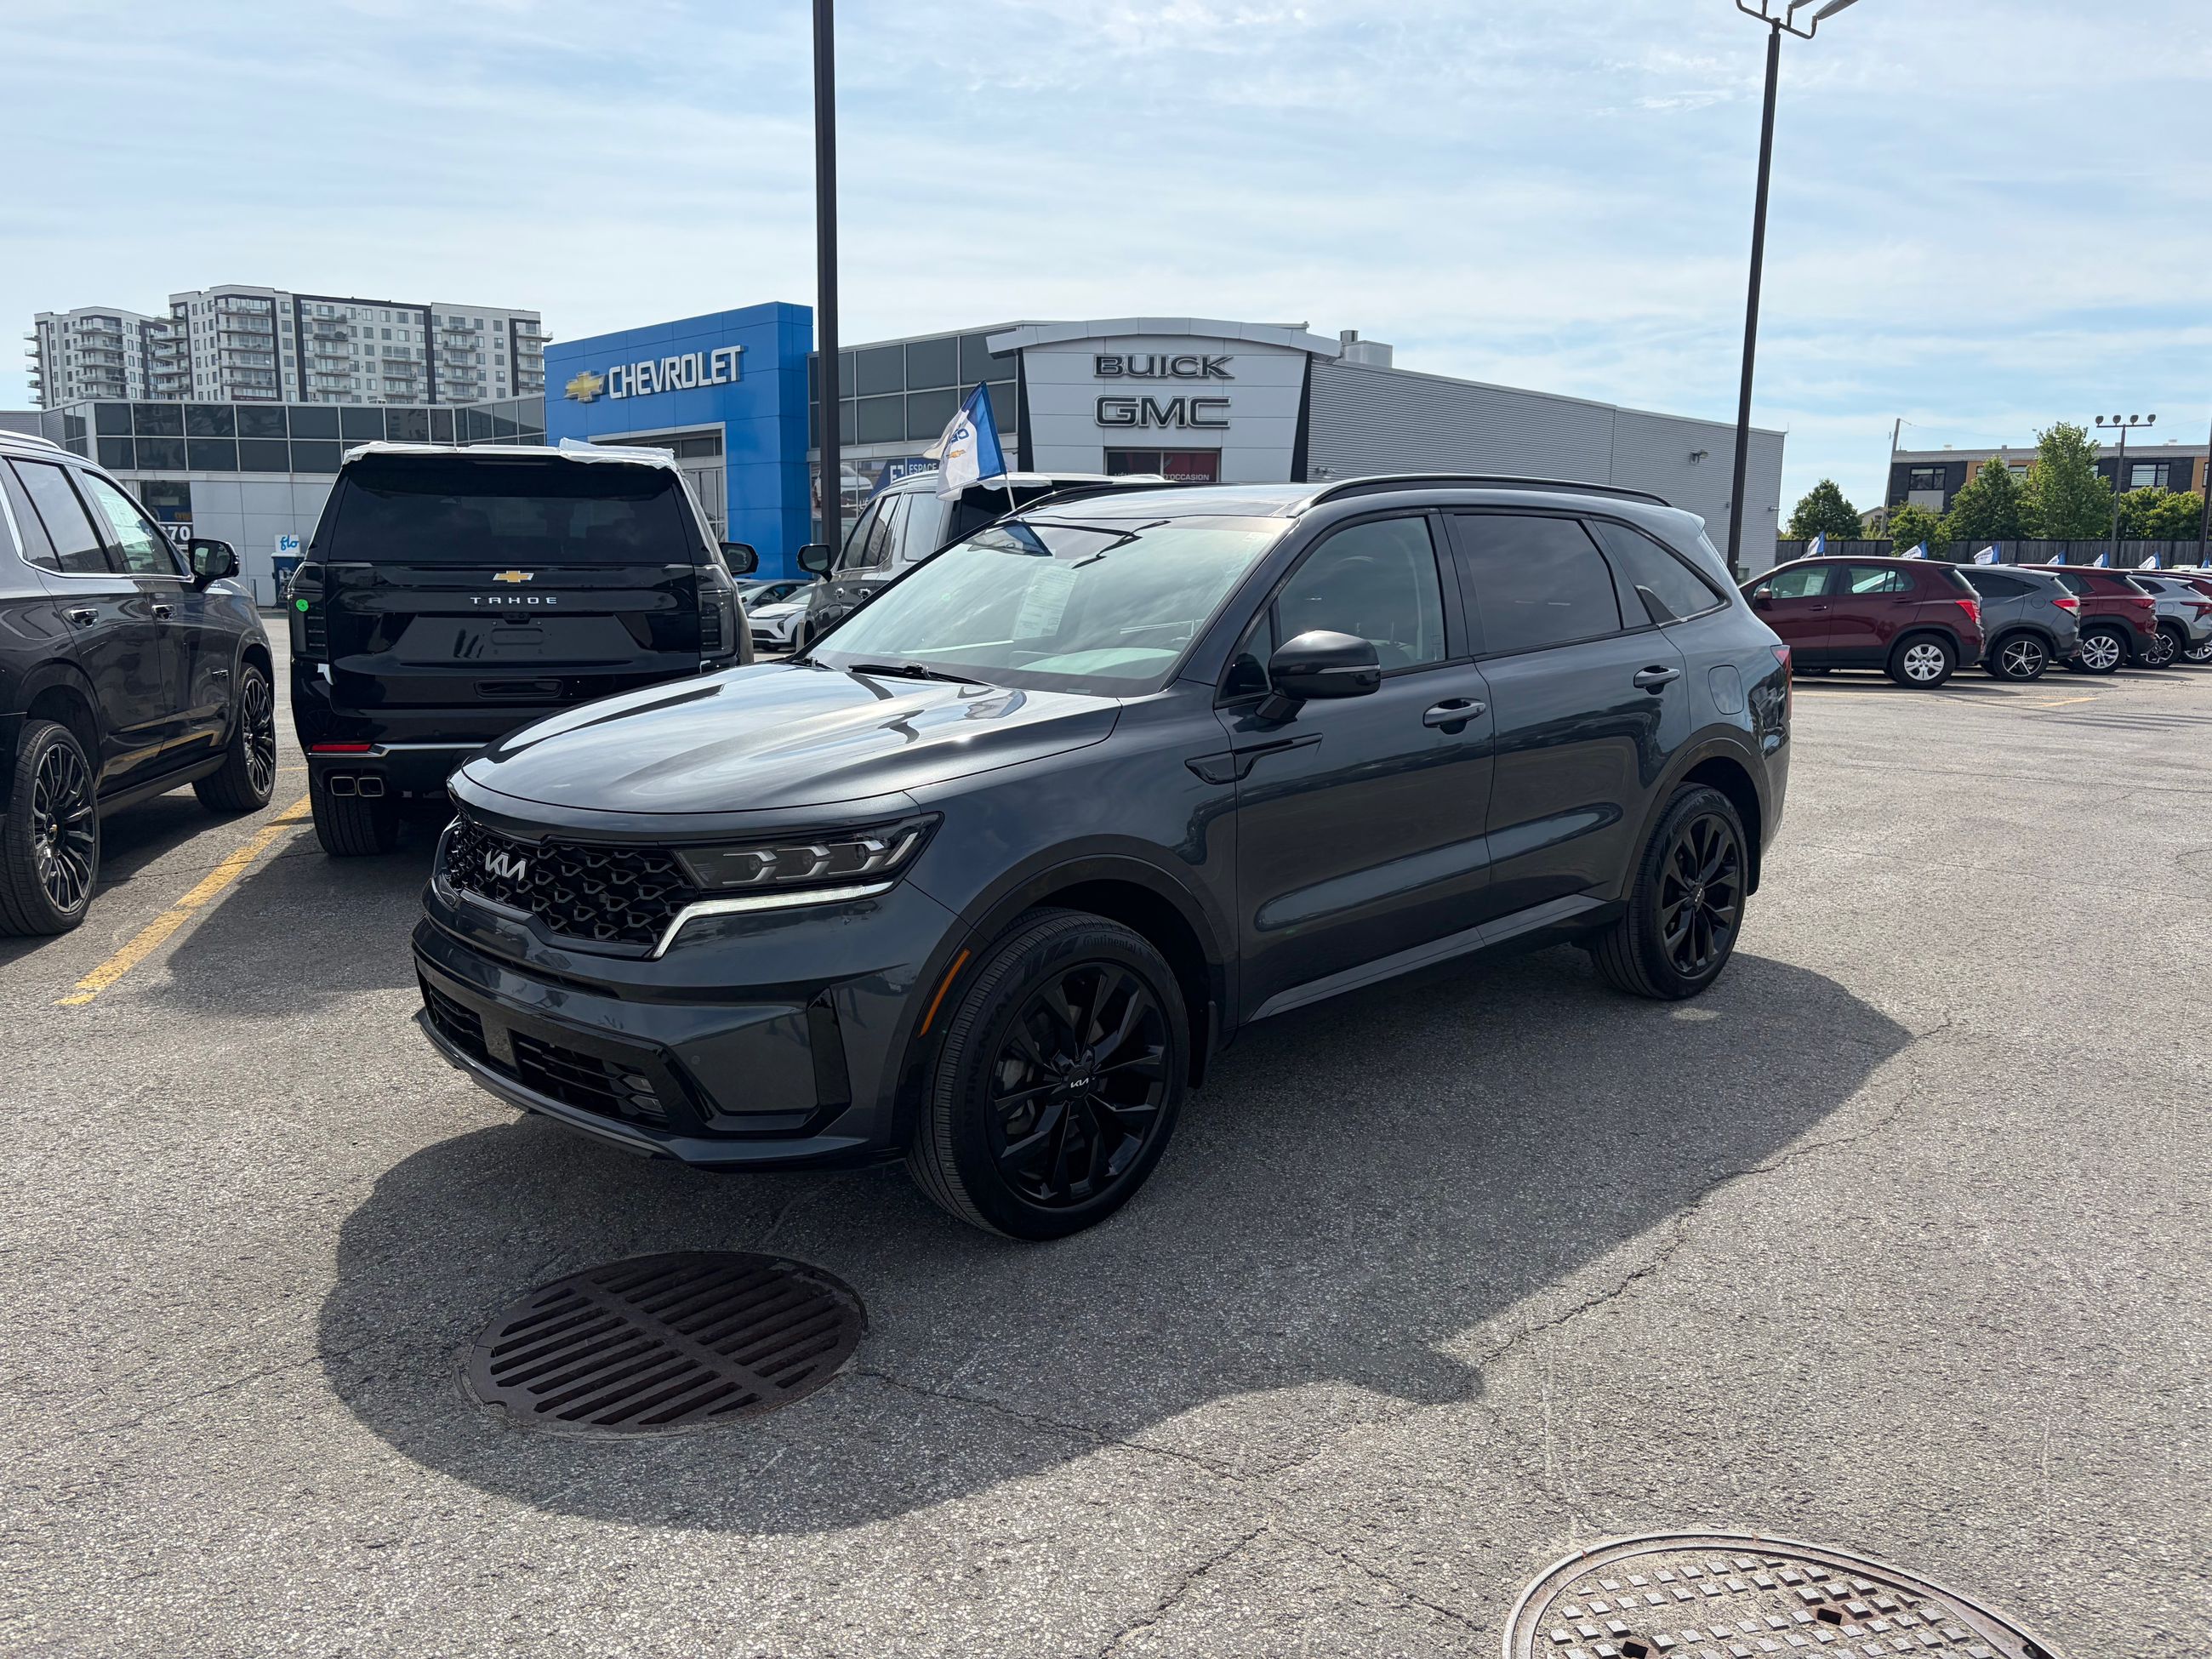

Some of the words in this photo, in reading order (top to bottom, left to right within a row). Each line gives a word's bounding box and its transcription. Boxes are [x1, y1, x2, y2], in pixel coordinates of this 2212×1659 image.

[608, 345, 742, 399] CHEVROLET
[1094, 354, 1234, 378] BUICK
[1095, 395, 1231, 428] GMC
[909, 463, 937, 474] ESPACE
[161, 525, 191, 541] 70
[280, 534, 299, 550] flo
[484, 851, 526, 881] KIA
[1070, 1077, 1089, 1088] KIA
